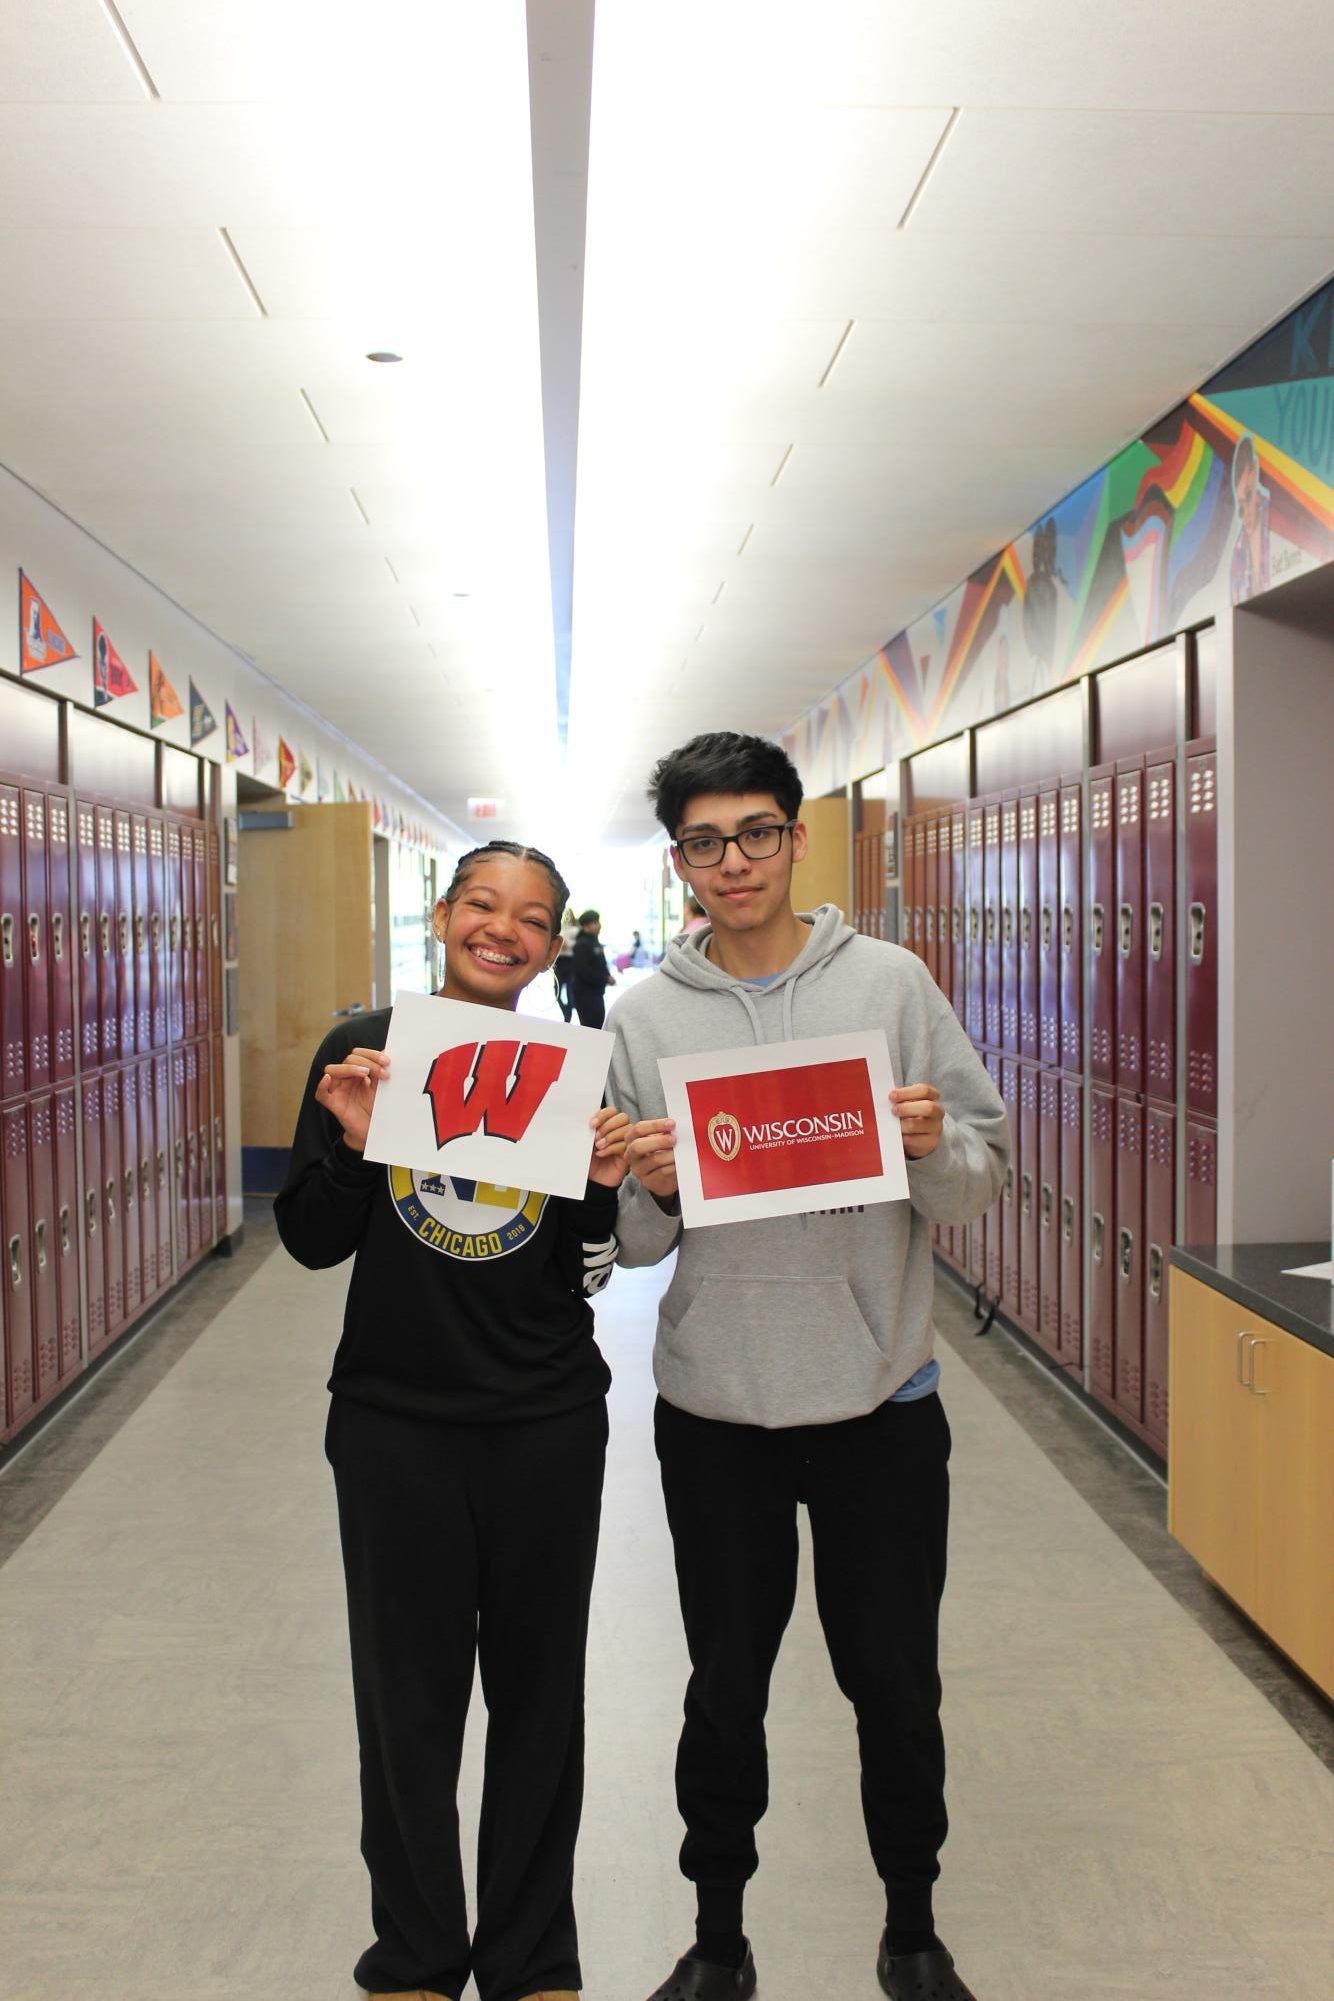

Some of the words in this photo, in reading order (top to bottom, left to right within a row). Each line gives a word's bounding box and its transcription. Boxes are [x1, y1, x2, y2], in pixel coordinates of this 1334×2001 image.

[422, 1039, 568, 1151] W
[716, 1128, 733, 1152] W
[743, 1110, 864, 1144] WISCONSIN
[750, 1140, 785, 1151] UNIVERSITY
[418, 1217, 503, 1258] CHICAGO
